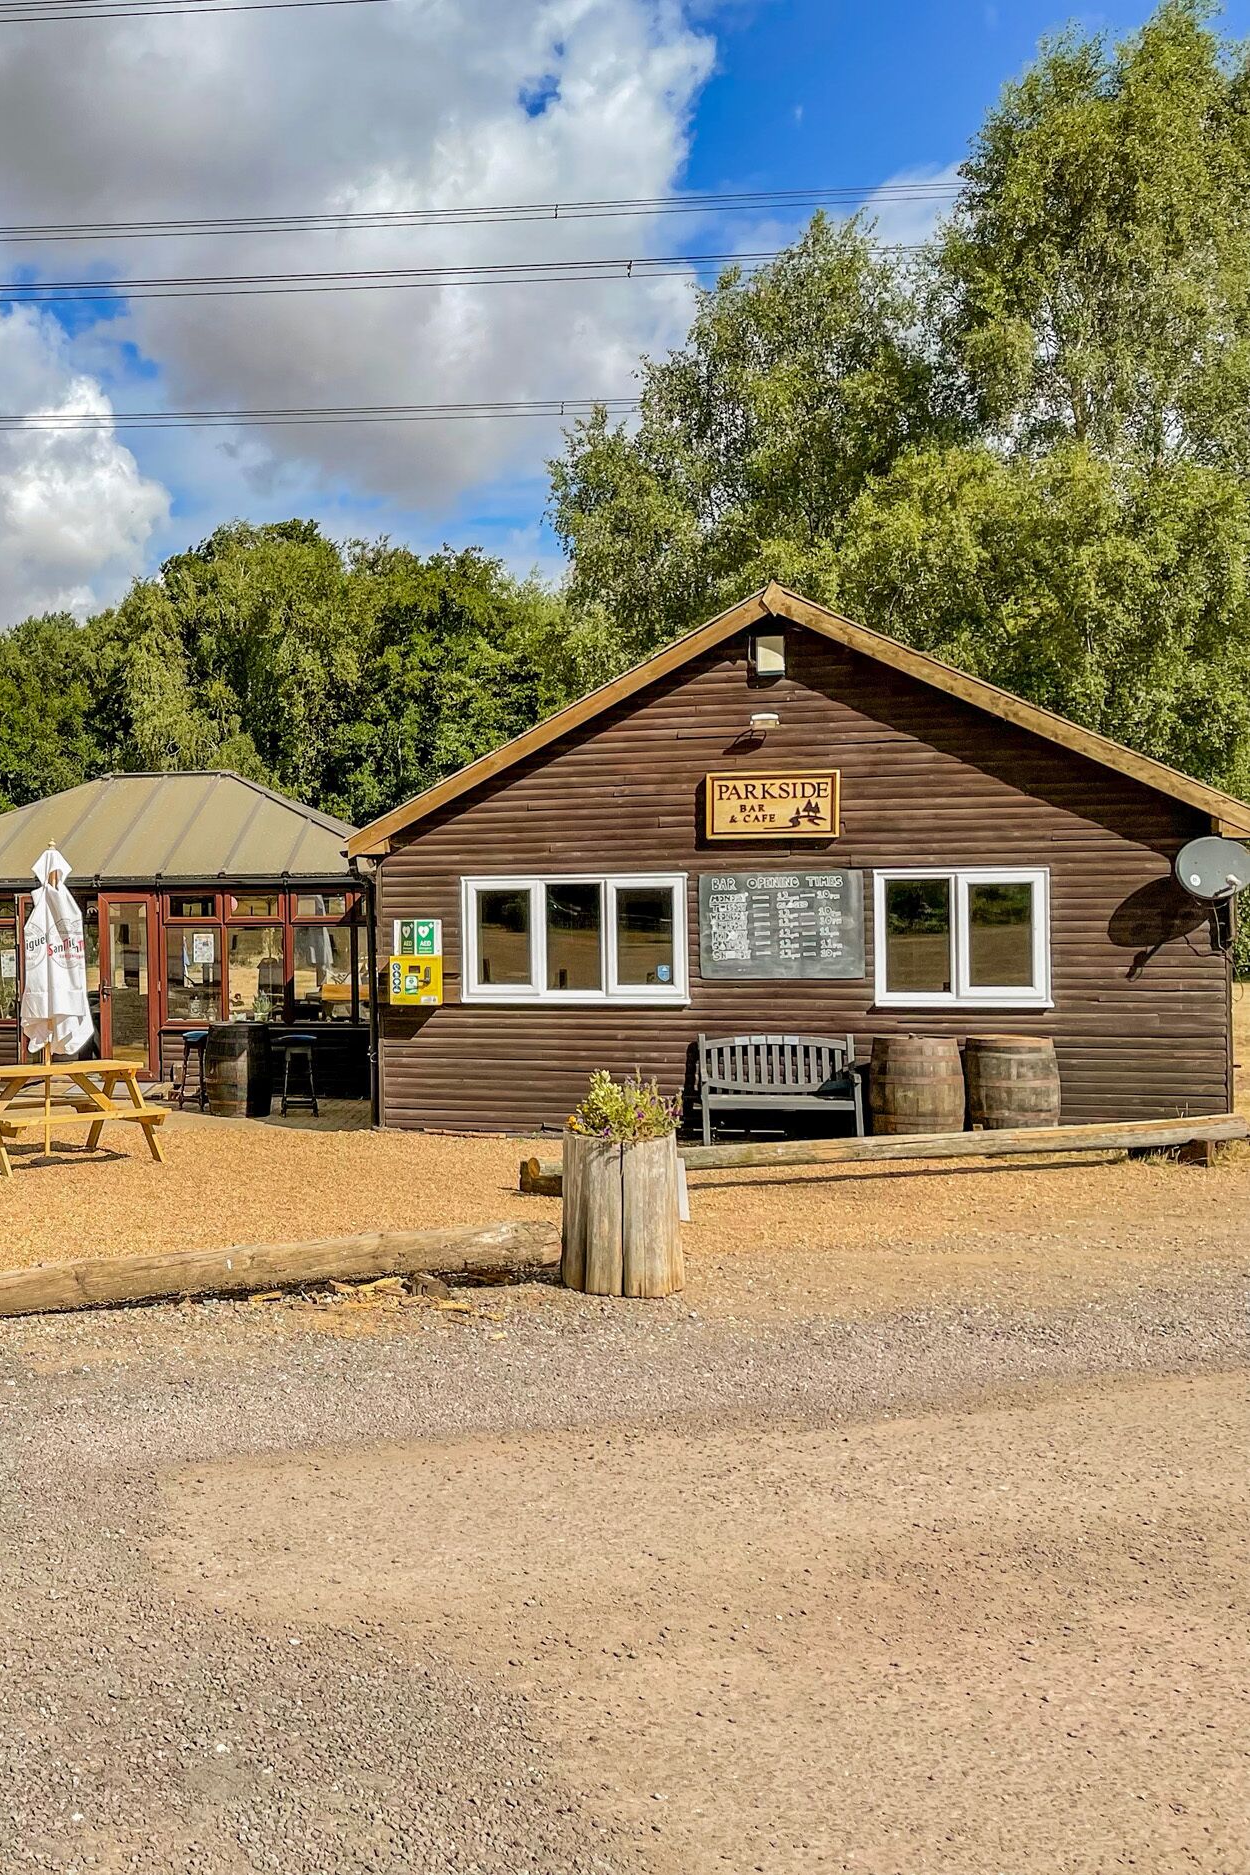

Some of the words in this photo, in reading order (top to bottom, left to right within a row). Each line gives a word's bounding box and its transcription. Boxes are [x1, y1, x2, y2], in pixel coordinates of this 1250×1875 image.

[717, 782, 829, 800] PARKSIDE
[739, 804, 766, 813] BAR
[729, 815, 738, 823] &
[743, 813, 776, 823] CAFE
[711, 877, 737, 891] BAR
[746, 876, 800, 889] OPENING
[805, 875, 844, 888] TIMES
